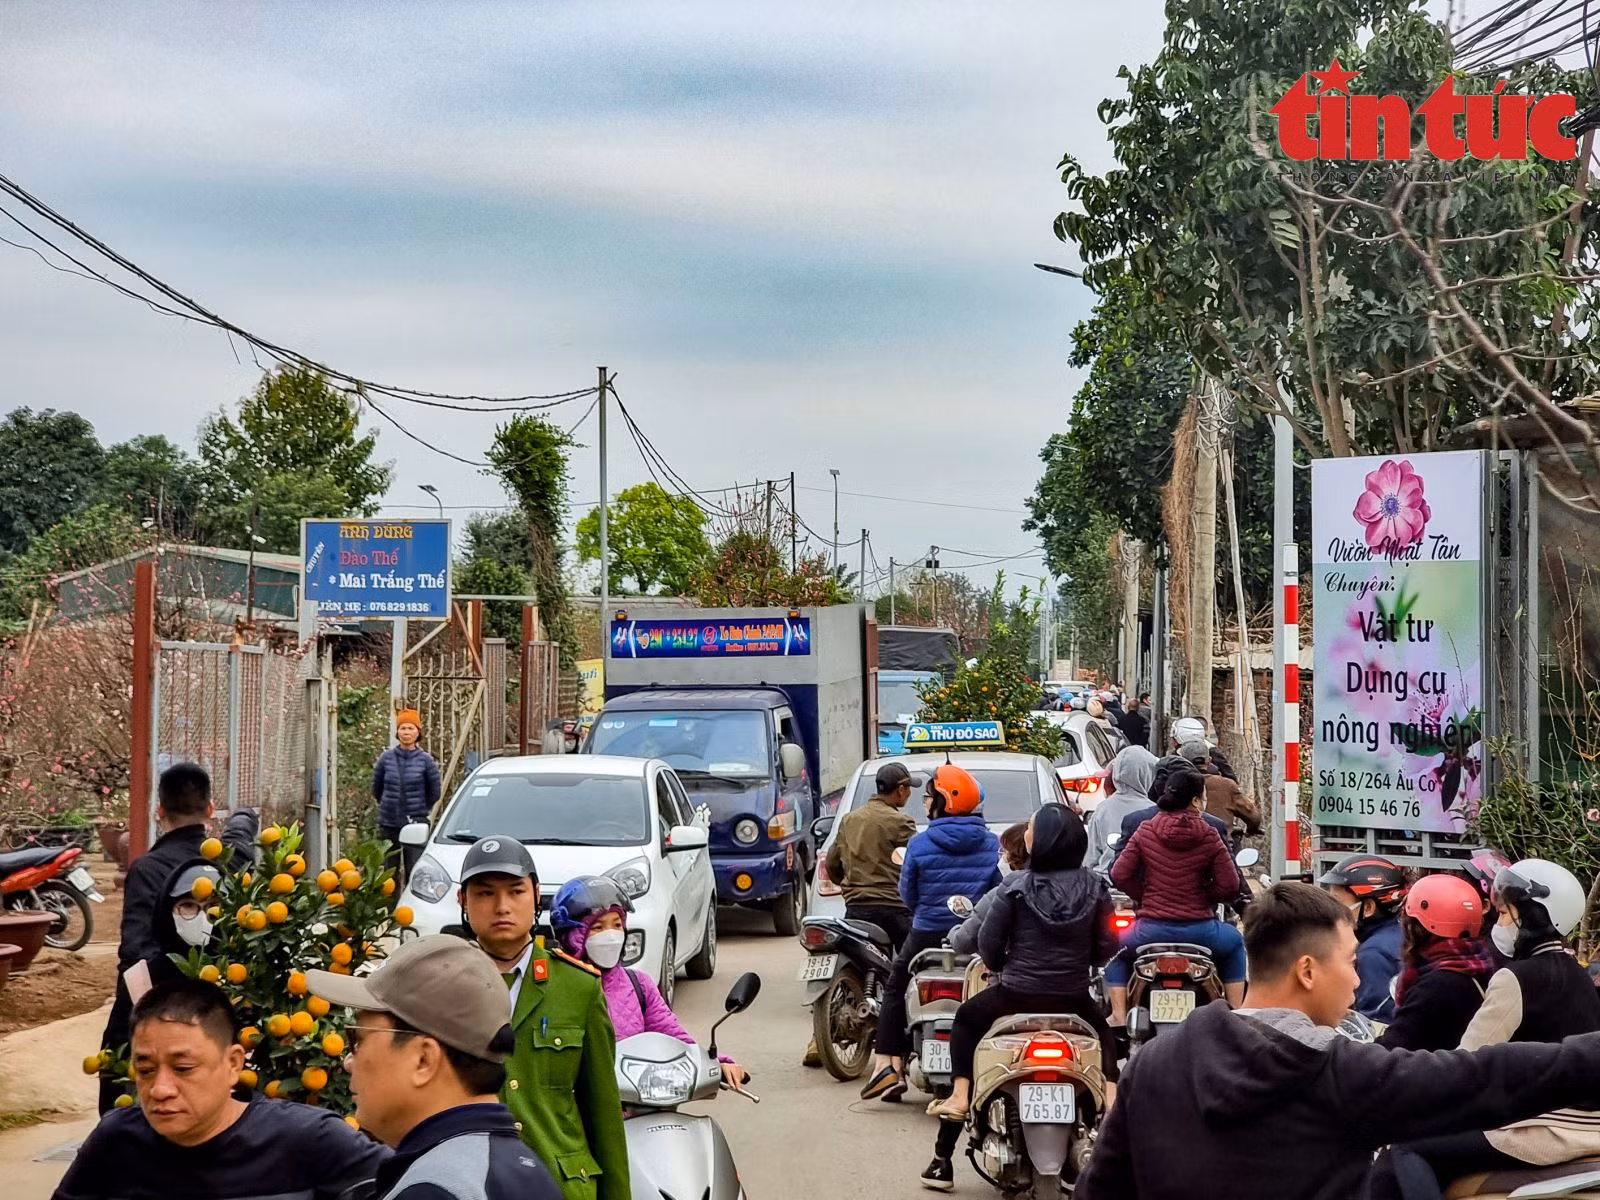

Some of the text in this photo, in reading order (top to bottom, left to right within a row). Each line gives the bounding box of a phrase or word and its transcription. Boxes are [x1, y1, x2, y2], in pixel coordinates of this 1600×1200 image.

[340, 547, 398, 566] Đào Thế
[1328, 534, 1461, 567] Vườn Nhật Tân
[338, 569, 446, 592] Mai Trắng Thế
[1324, 571, 1395, 600] Chuyên:
[1358, 611, 1434, 650] Vật tư
[1347, 661, 1447, 702] Dụng cụ
[955, 726, 974, 740] ĐÔ
[974, 727, 998, 739] SAO
[1322, 712, 1379, 752] nông
[1319, 769, 1438, 793] Số 18/264 Âu Cơ
[1319, 797, 1420, 817] 0904 15 46 76
[803, 967, 829, 979] 2900
[1028, 1086, 1065, 1102] 29-K1
[1024, 1103, 1070, 1120] 765.87
